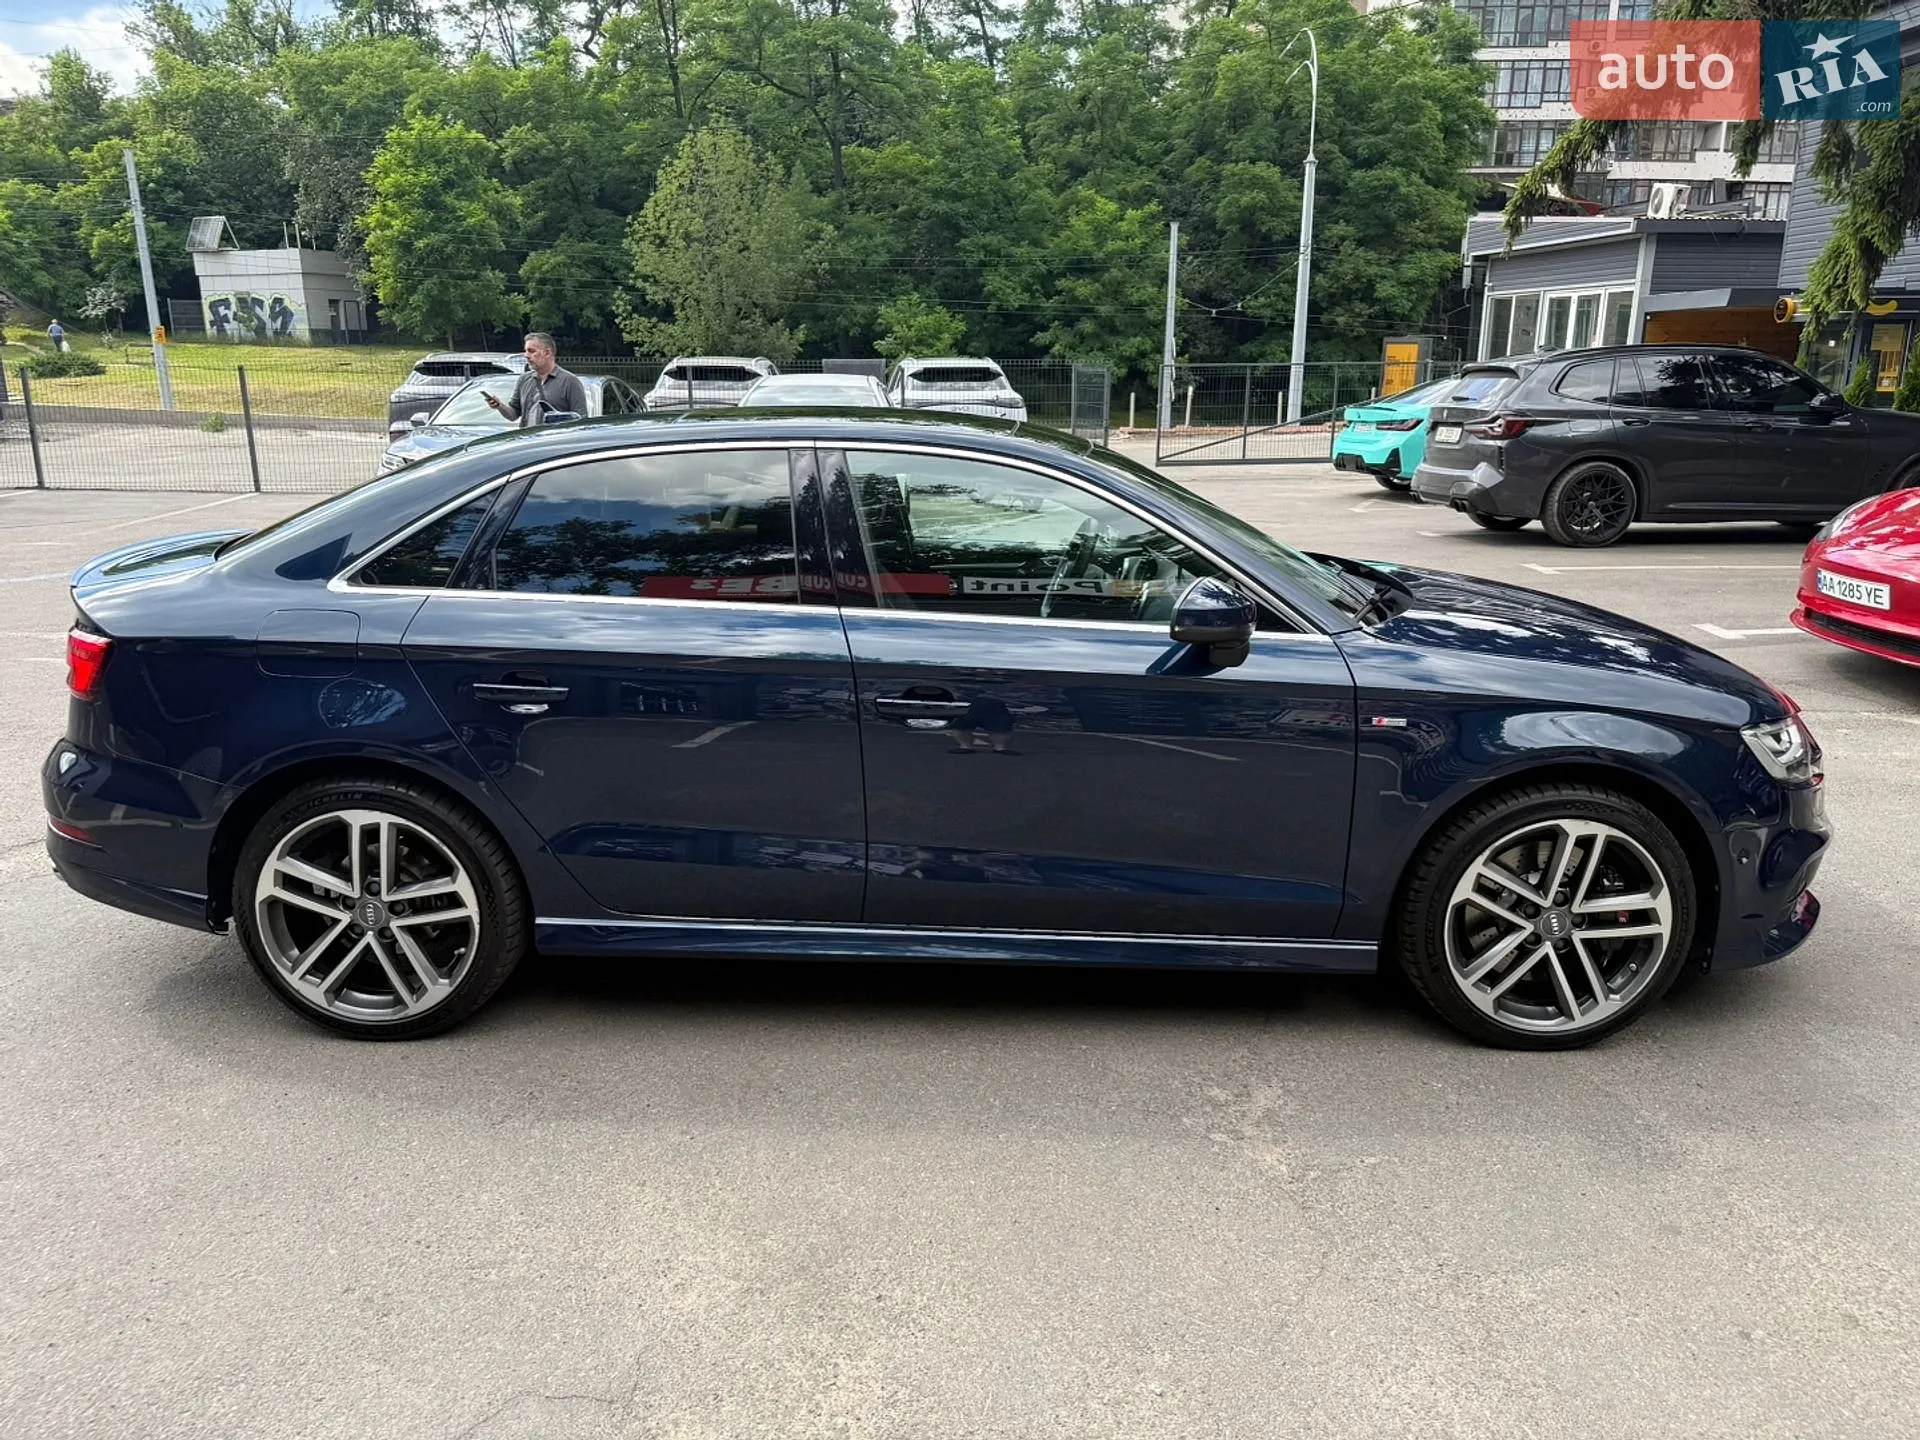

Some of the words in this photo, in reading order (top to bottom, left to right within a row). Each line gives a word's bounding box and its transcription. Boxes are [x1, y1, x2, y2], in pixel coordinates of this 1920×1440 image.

[1821, 574, 1835, 593] AA
[1836, 580, 1862, 600] 1285
[1865, 586, 1884, 606] YE
